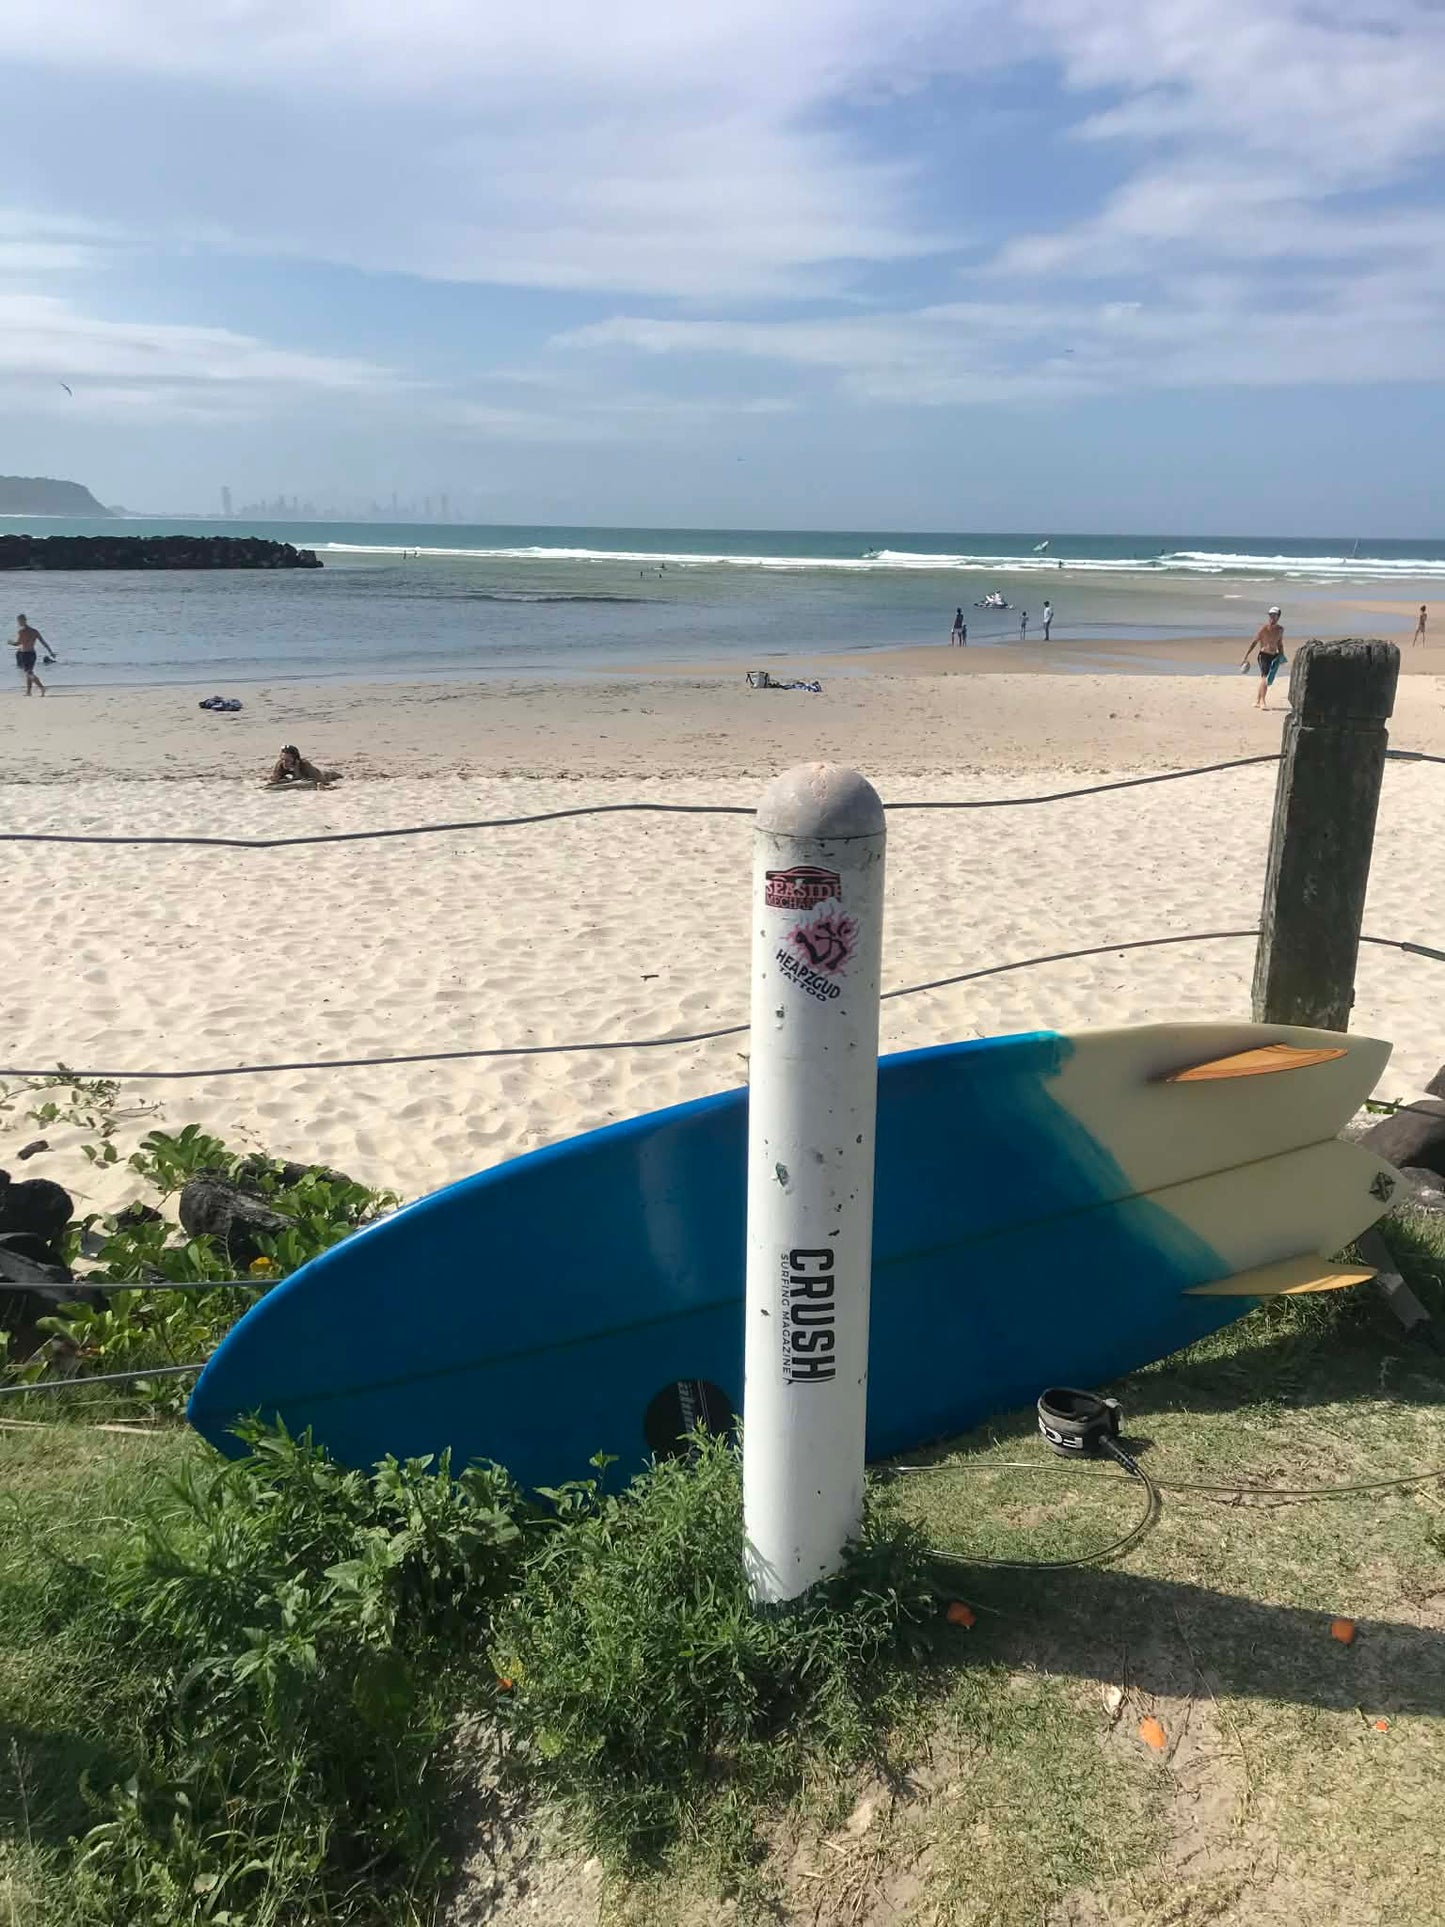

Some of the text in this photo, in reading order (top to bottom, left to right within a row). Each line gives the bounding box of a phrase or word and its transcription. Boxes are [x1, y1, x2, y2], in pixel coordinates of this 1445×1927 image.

[775, 949, 841, 999] HEAPZGUD
[779, 966, 827, 1002] TATTOO
[780, 1252, 792, 1375] SURFING MAGAZINE
[789, 1249, 836, 1379] CRUSH
